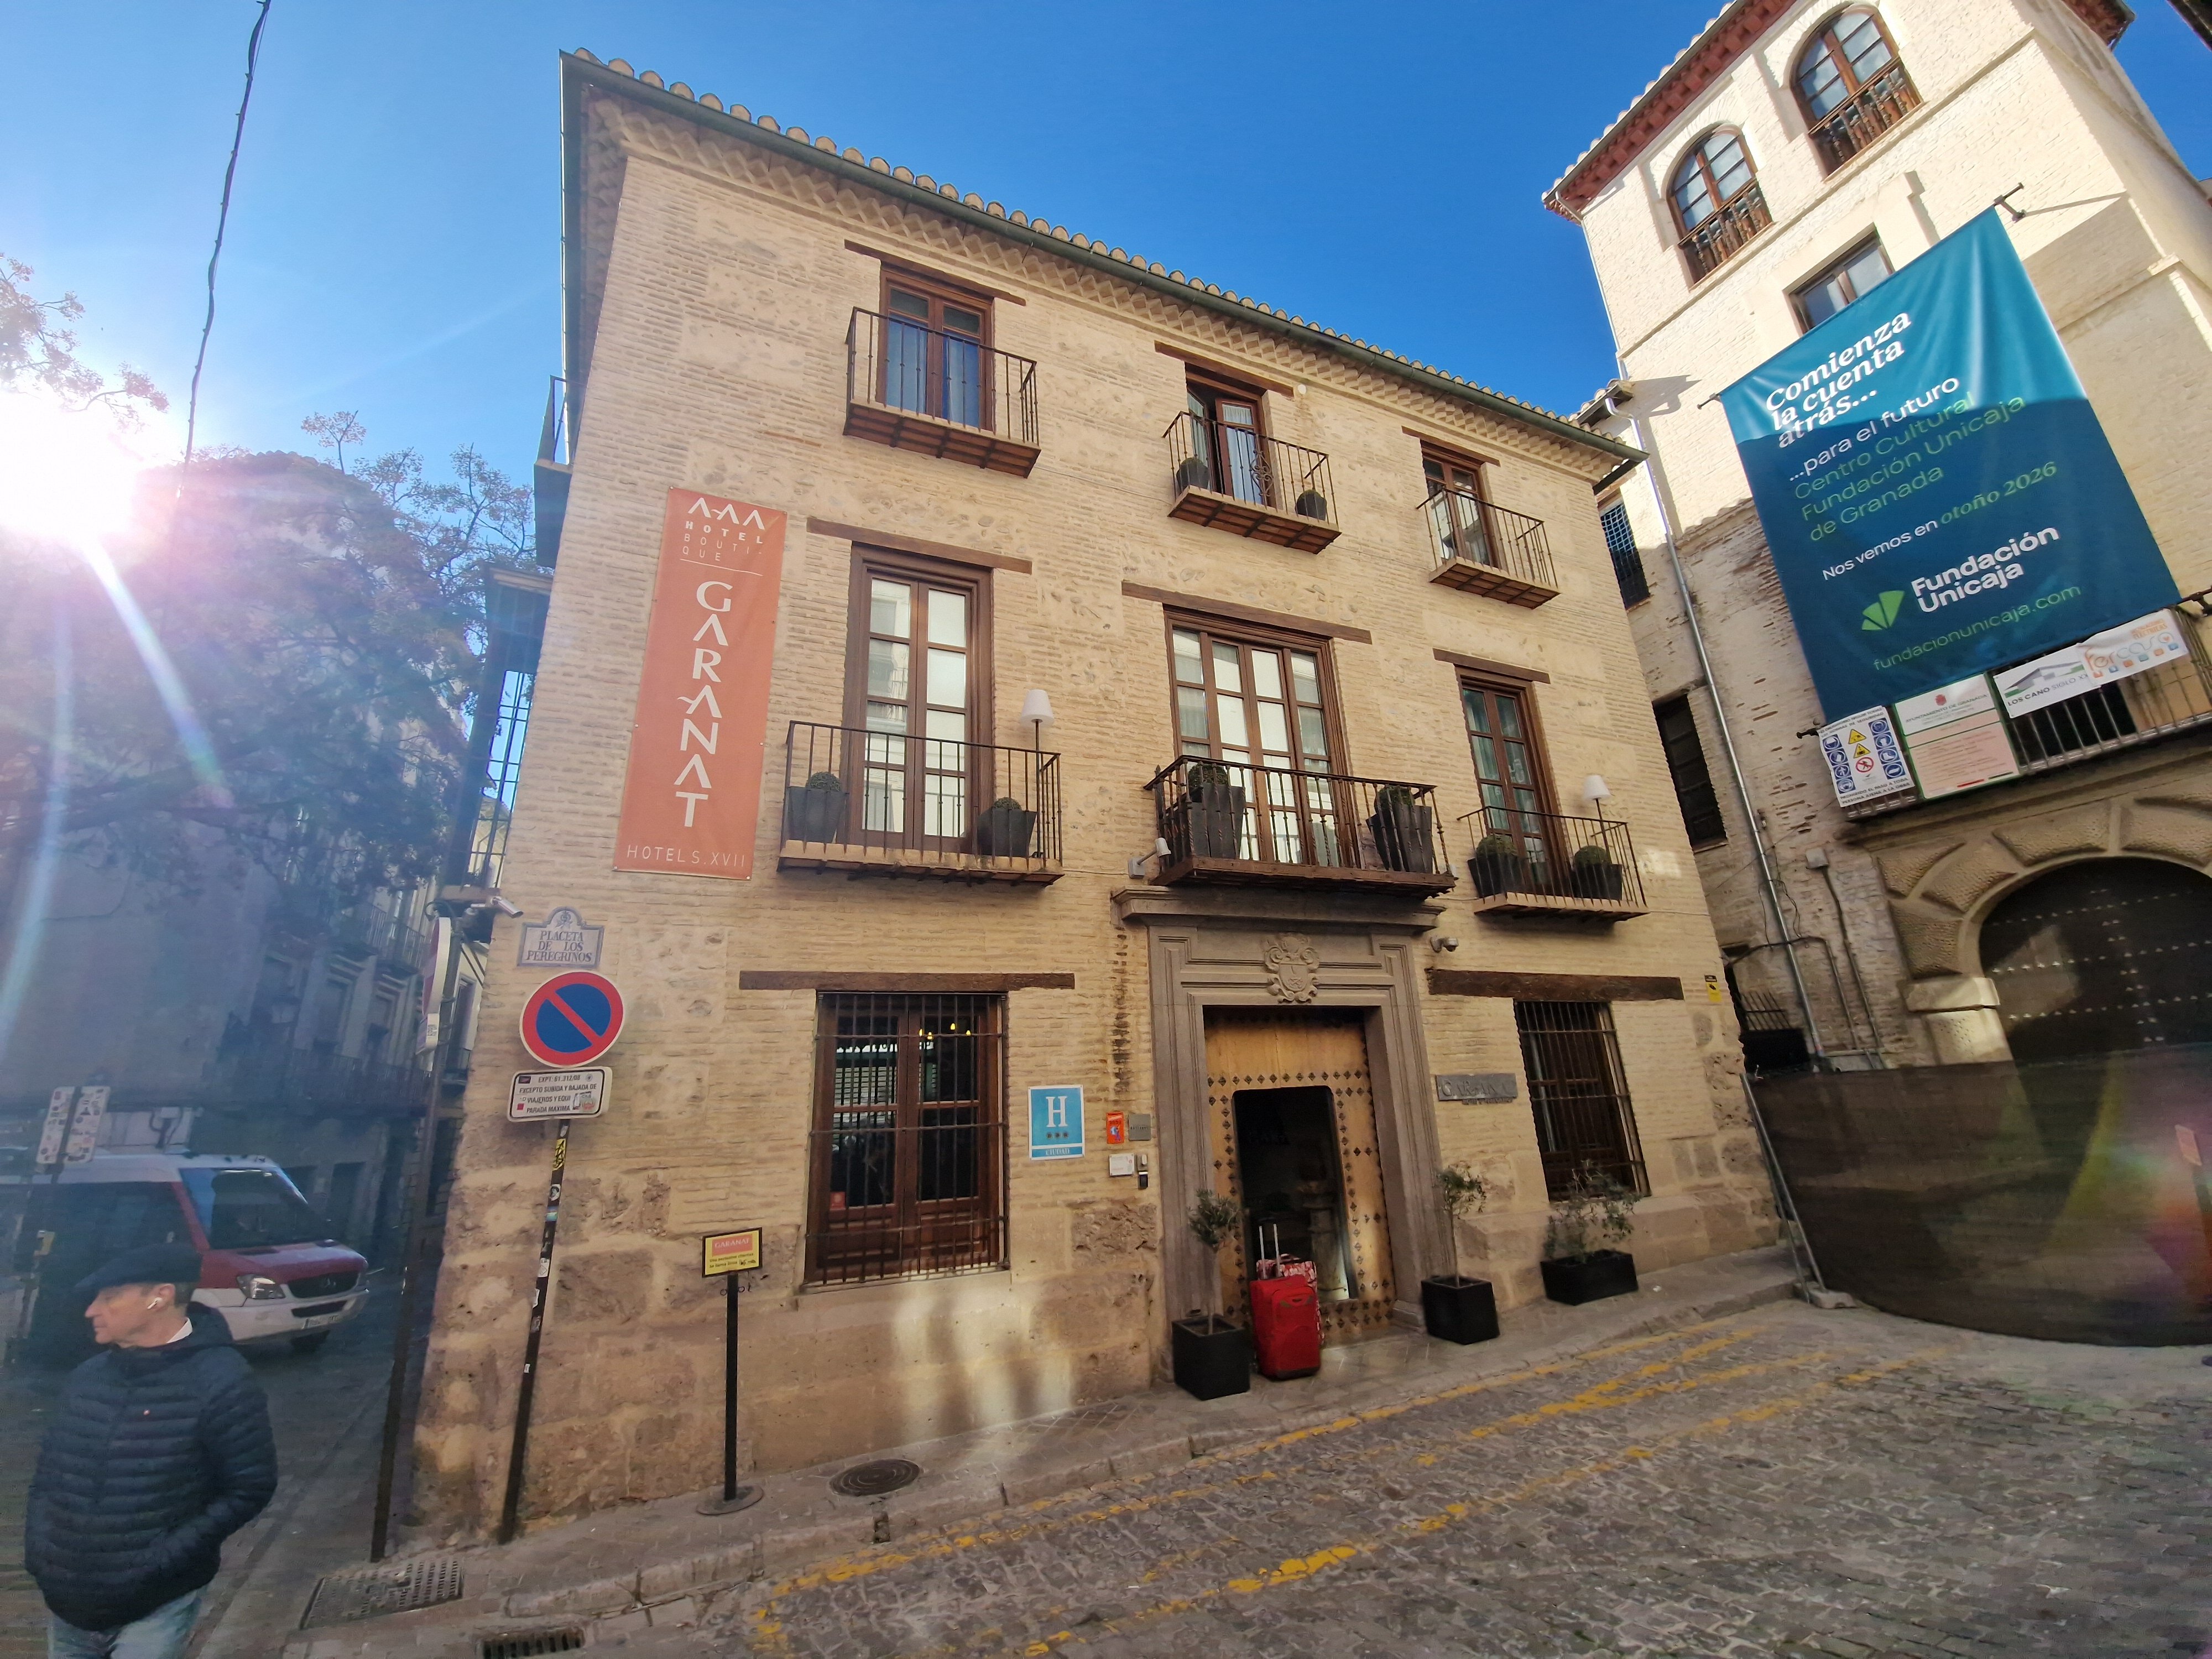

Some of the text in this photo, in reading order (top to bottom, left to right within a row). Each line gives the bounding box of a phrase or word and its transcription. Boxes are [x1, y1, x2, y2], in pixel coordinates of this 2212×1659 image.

[1766, 312, 1911, 411] Comienza
[1771, 341, 1905, 431] la cuenta
[1778, 390, 1877, 448] atrás...
[1790, 377, 1959, 481] ...para el futuro
[1795, 391, 1975, 500] Centro Cultural
[1802, 395, 2026, 520] Fundación Unicaja
[1811, 466, 1944, 541] de Granada
[1822, 462, 2057, 580] Nos vemos en otoño 2026
[682, 546, 721, 561] QUE
[685, 521, 763, 544] HOTEL
[1911, 527, 2060, 597] Fundación
[1917, 562, 2025, 613] Unicaja
[1873, 586, 2082, 671] fundacionunicaja.com
[1906, 707, 1947, 722] AYUNTAMIENTO
[1958, 695, 1987, 706] GRANADA
[2007, 673, 2089, 706] LOS CANO SIGLO XX
[627, 844, 686, 862] HOTEL
[526, 951, 592, 962] PEREGRINOS
[538, 941, 584, 951] DE LOS
[540, 930, 584, 941] PLACETA
[1045, 1095, 1068, 1128] H
[714, 1238, 750, 1248] GARANAT
